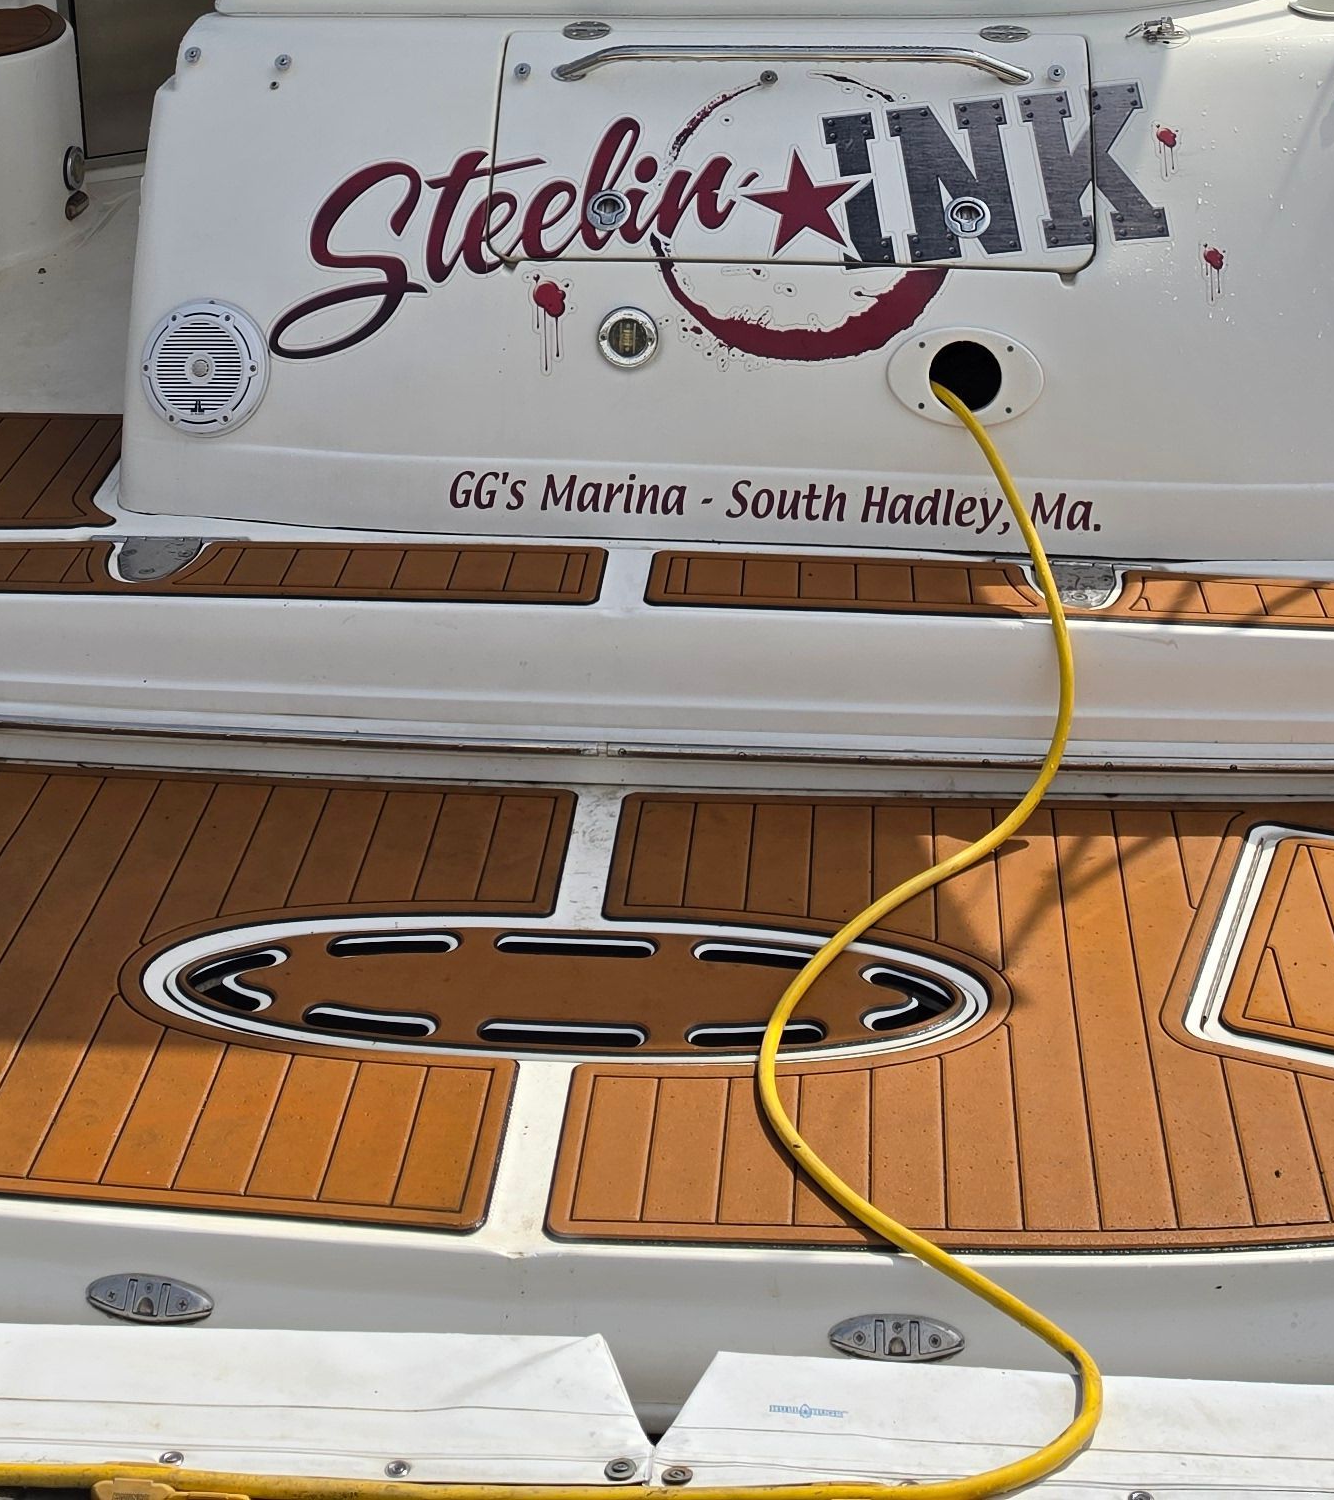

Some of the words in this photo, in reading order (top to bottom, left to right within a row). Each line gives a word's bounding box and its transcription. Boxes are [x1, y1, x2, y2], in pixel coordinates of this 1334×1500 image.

[822, 82, 1170, 270] INK
[449, 470, 527, 511] GG's
[540, 473, 688, 516] Marina
[701, 497, 714, 505] -
[725, 480, 847, 523] South
[860, 485, 1011, 536] Hadley,
[1030, 491, 1102, 532] Ma.
